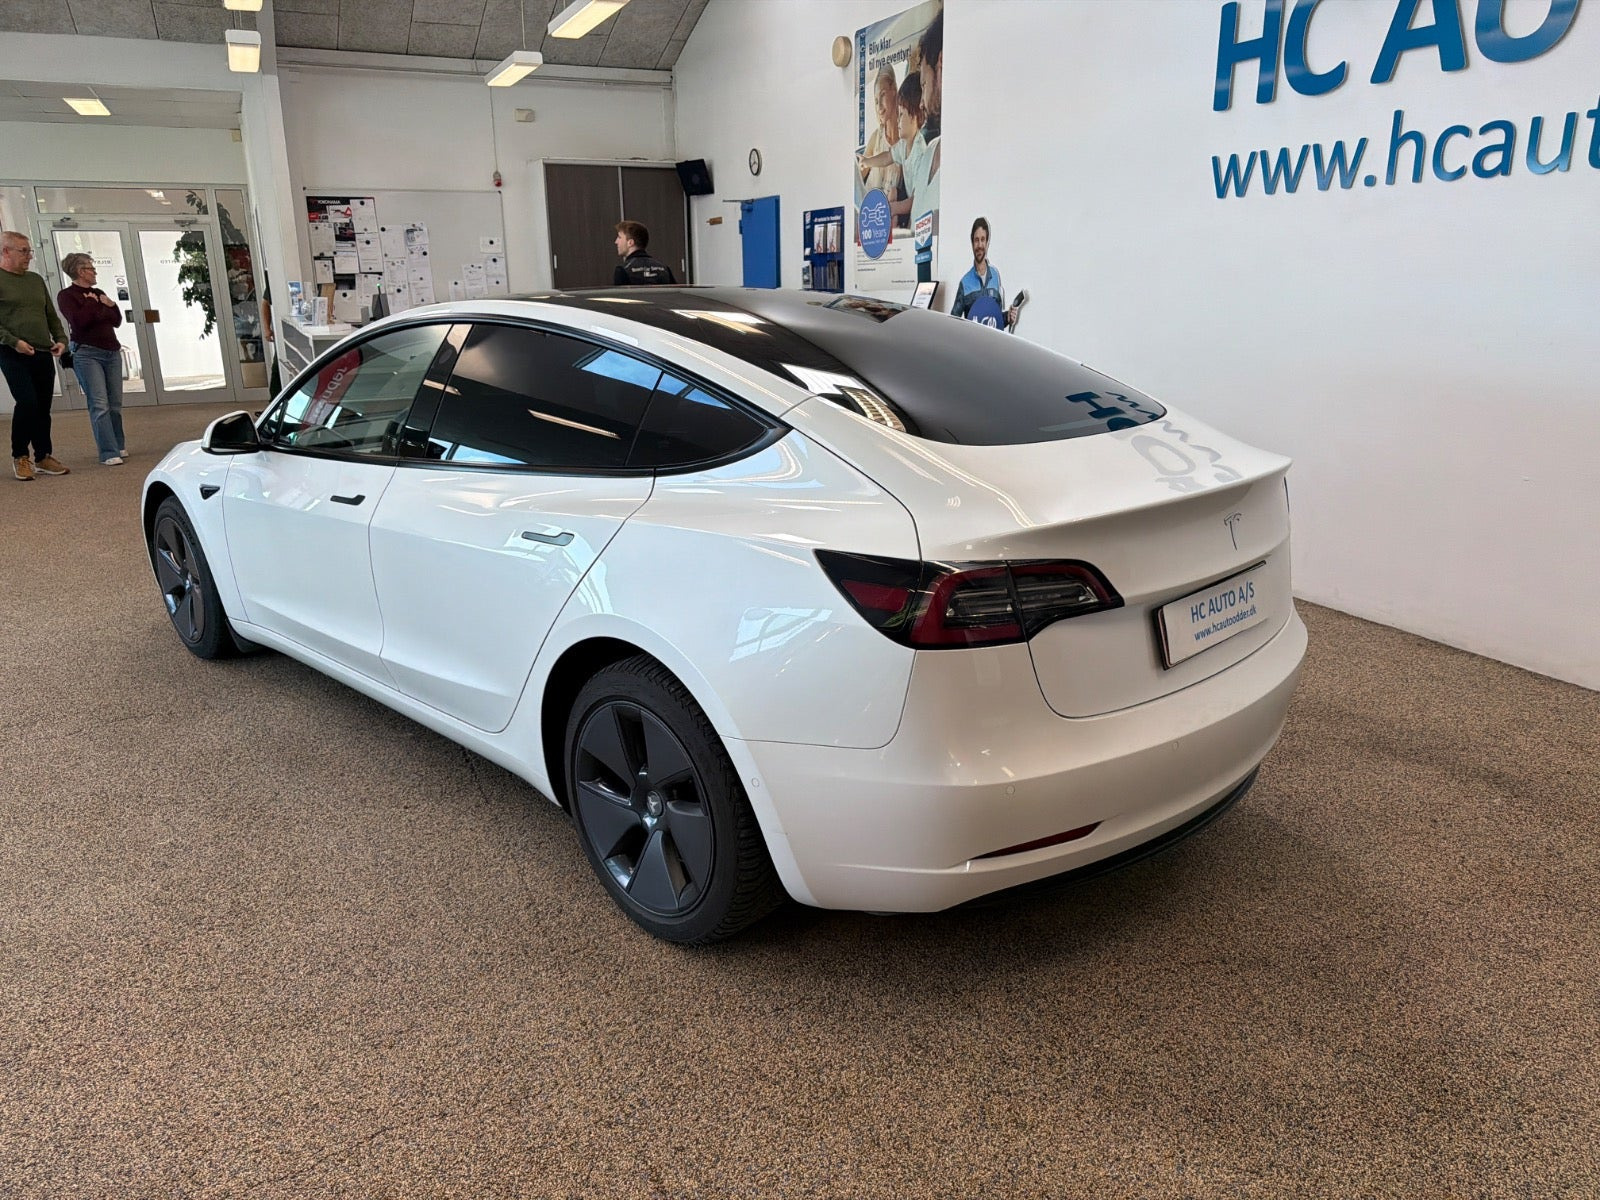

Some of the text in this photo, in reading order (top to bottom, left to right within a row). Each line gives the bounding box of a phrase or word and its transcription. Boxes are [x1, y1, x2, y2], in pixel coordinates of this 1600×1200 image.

[868, 37, 892, 55] Bliv klar
[876, 57, 886, 70] nye
[886, 44, 912, 65] eventyr!
[1213, 0, 1347, 111] HC
[861, 229, 872, 240] 100
[1190, 581, 1255, 623] HC AUTO A/S
[1194, 604, 1257, 641] www.hcautoodder.dk
